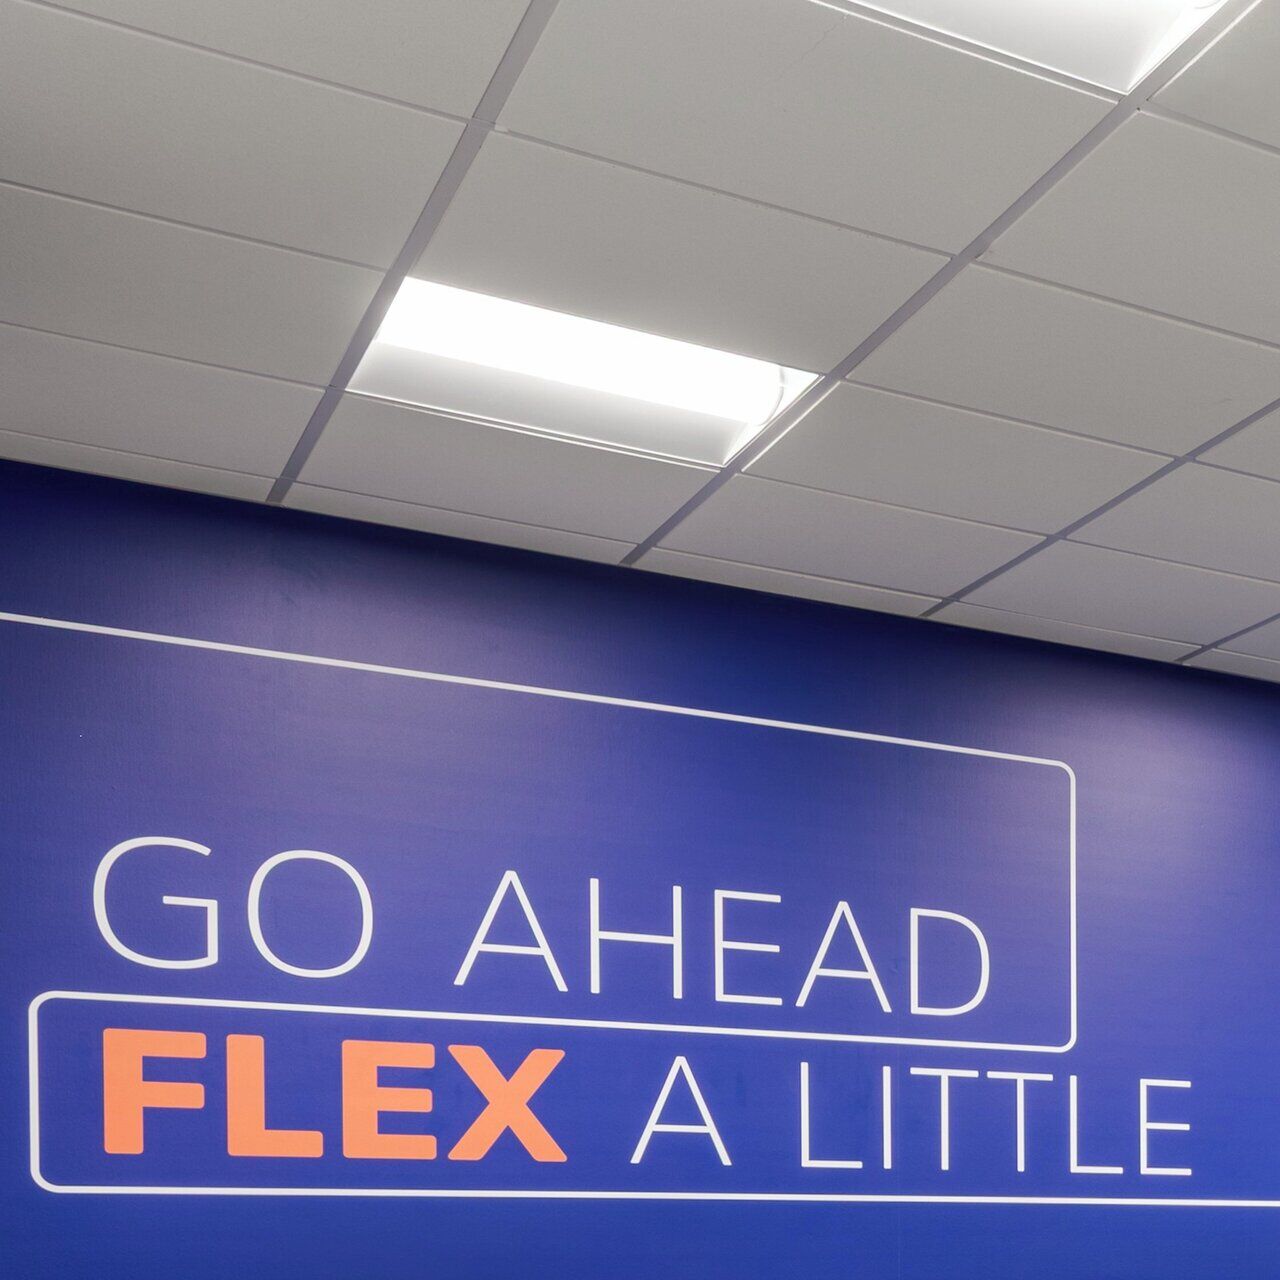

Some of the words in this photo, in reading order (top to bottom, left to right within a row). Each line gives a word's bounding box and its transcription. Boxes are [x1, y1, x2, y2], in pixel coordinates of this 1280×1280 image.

[92, 835, 374, 980] GO
[453, 869, 990, 1018] AHEAD
[103, 1028, 567, 1163] FLEX
[630, 1056, 733, 1167] A
[800, 1061, 1193, 1177] LITTLE
